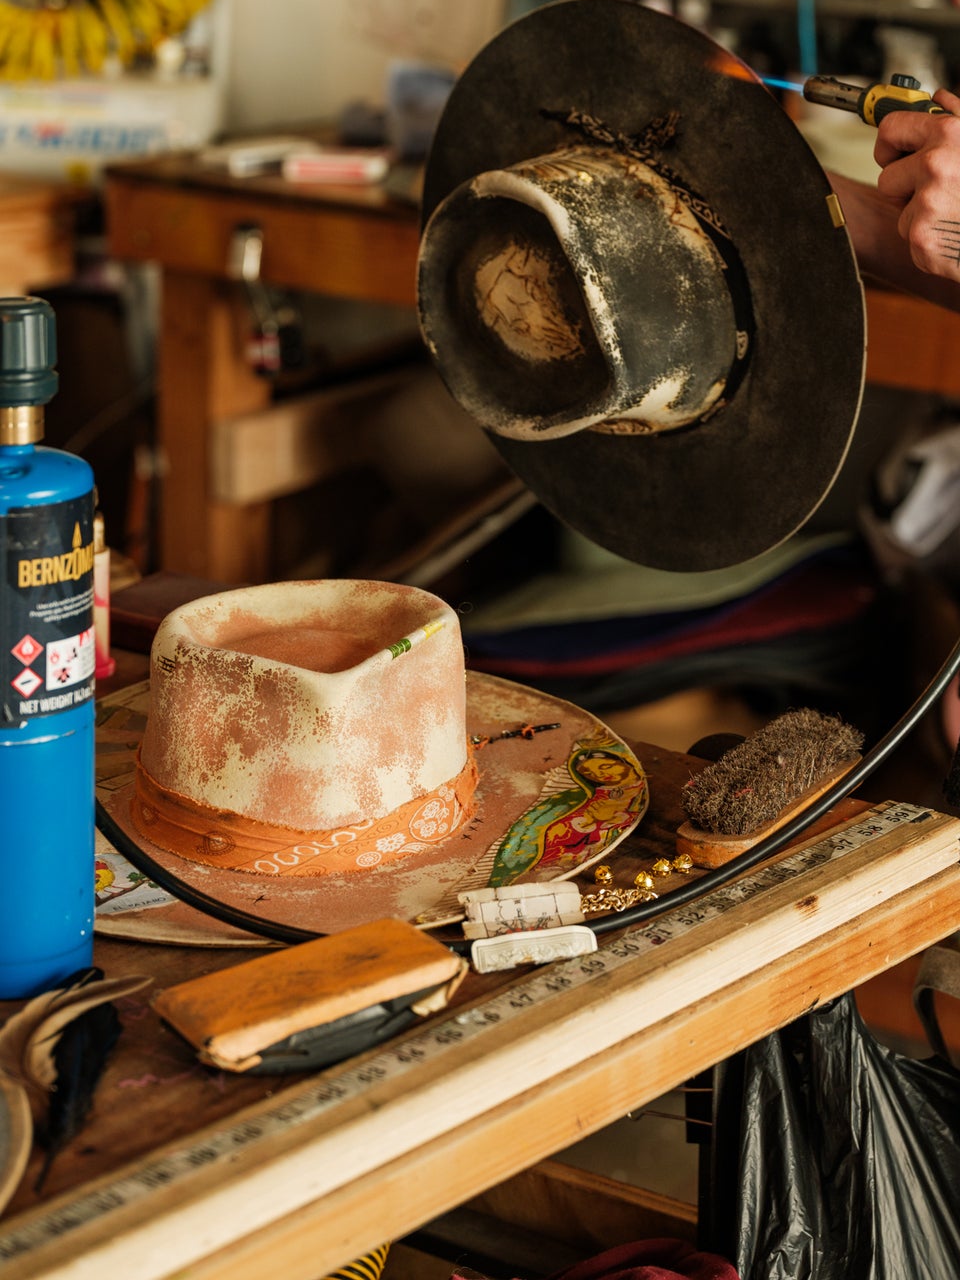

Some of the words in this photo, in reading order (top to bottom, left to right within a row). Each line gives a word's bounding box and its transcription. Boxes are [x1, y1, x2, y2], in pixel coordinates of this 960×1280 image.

[19, 699, 39, 715] NET
[40, 692, 74, 712] WEIGHT
[510, 993, 534, 1007] 47
[545, 976, 572, 991] 48
[581, 960, 605, 975] 49
[612, 943, 640, 958] 50
[645, 928, 672, 945] 51
[678, 911, 705, 926] 52
[832, 838, 854, 851] 57
[857, 824, 883, 837] 58
[885, 811, 910, 823] 59
